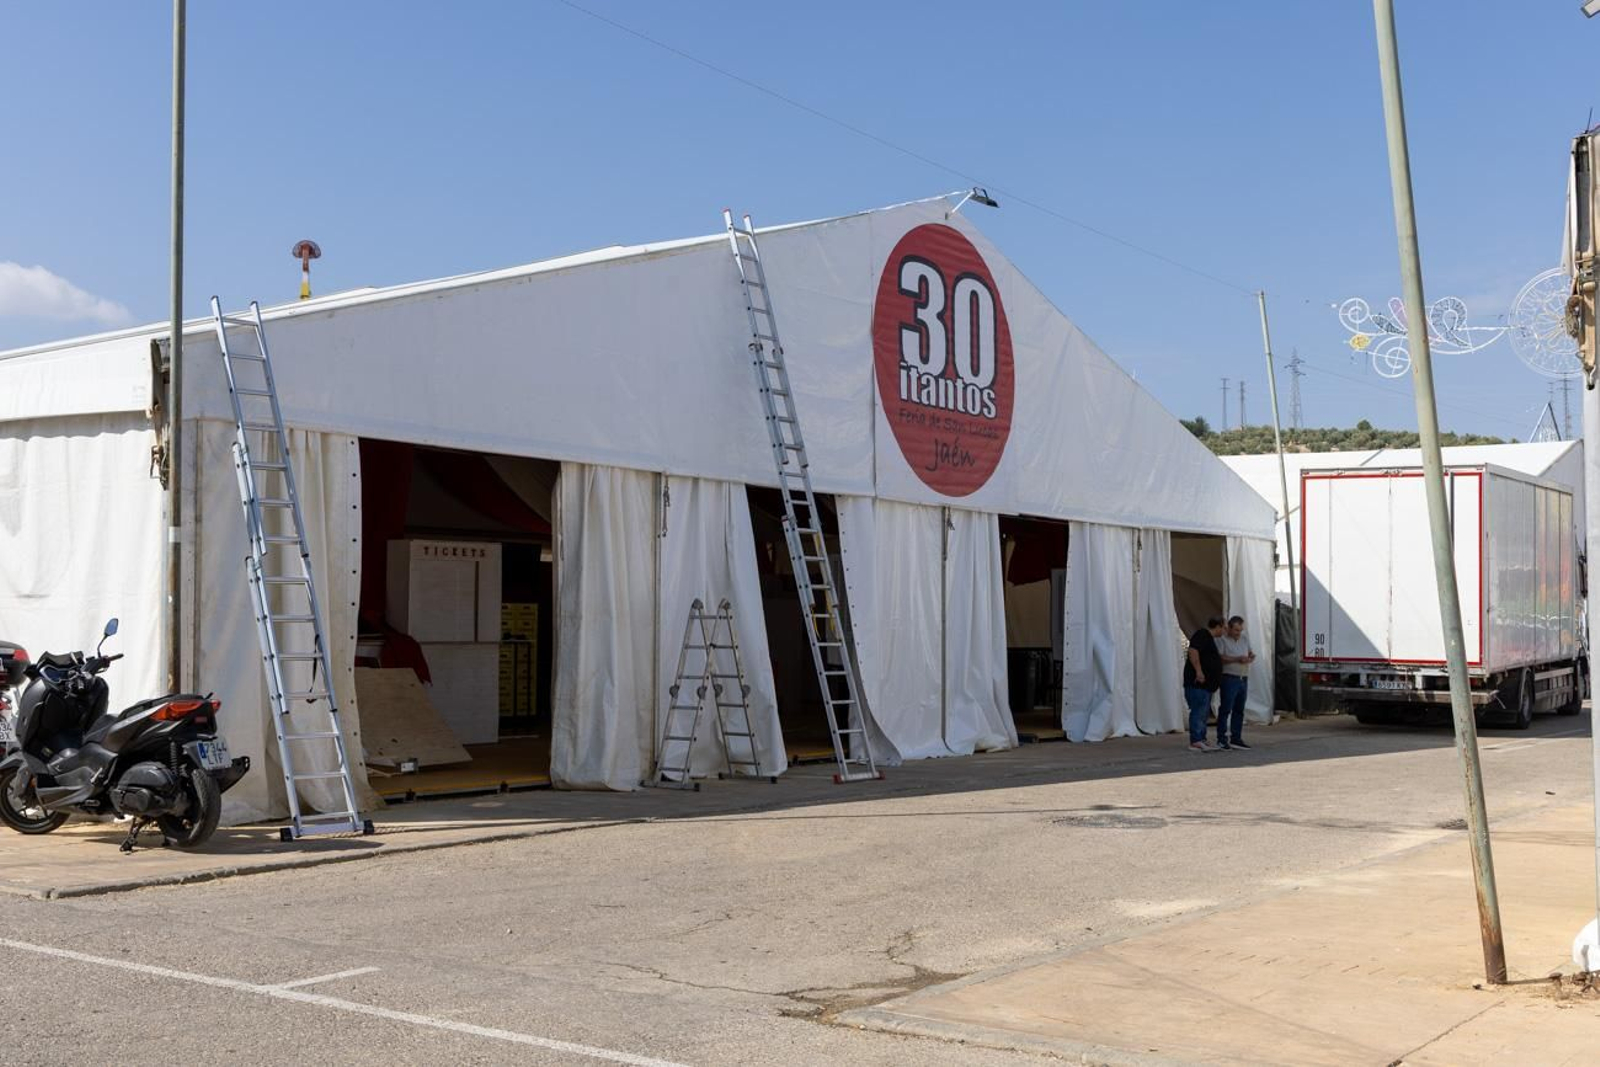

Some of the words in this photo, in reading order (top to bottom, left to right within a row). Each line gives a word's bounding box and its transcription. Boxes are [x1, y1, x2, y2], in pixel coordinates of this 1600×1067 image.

[899, 255, 996, 389] 30
[900, 361, 997, 418] itantos
[423, 546, 486, 557] TICKETS
[1314, 633, 1325, 645] 90
[203, 742, 227, 754] 7344
